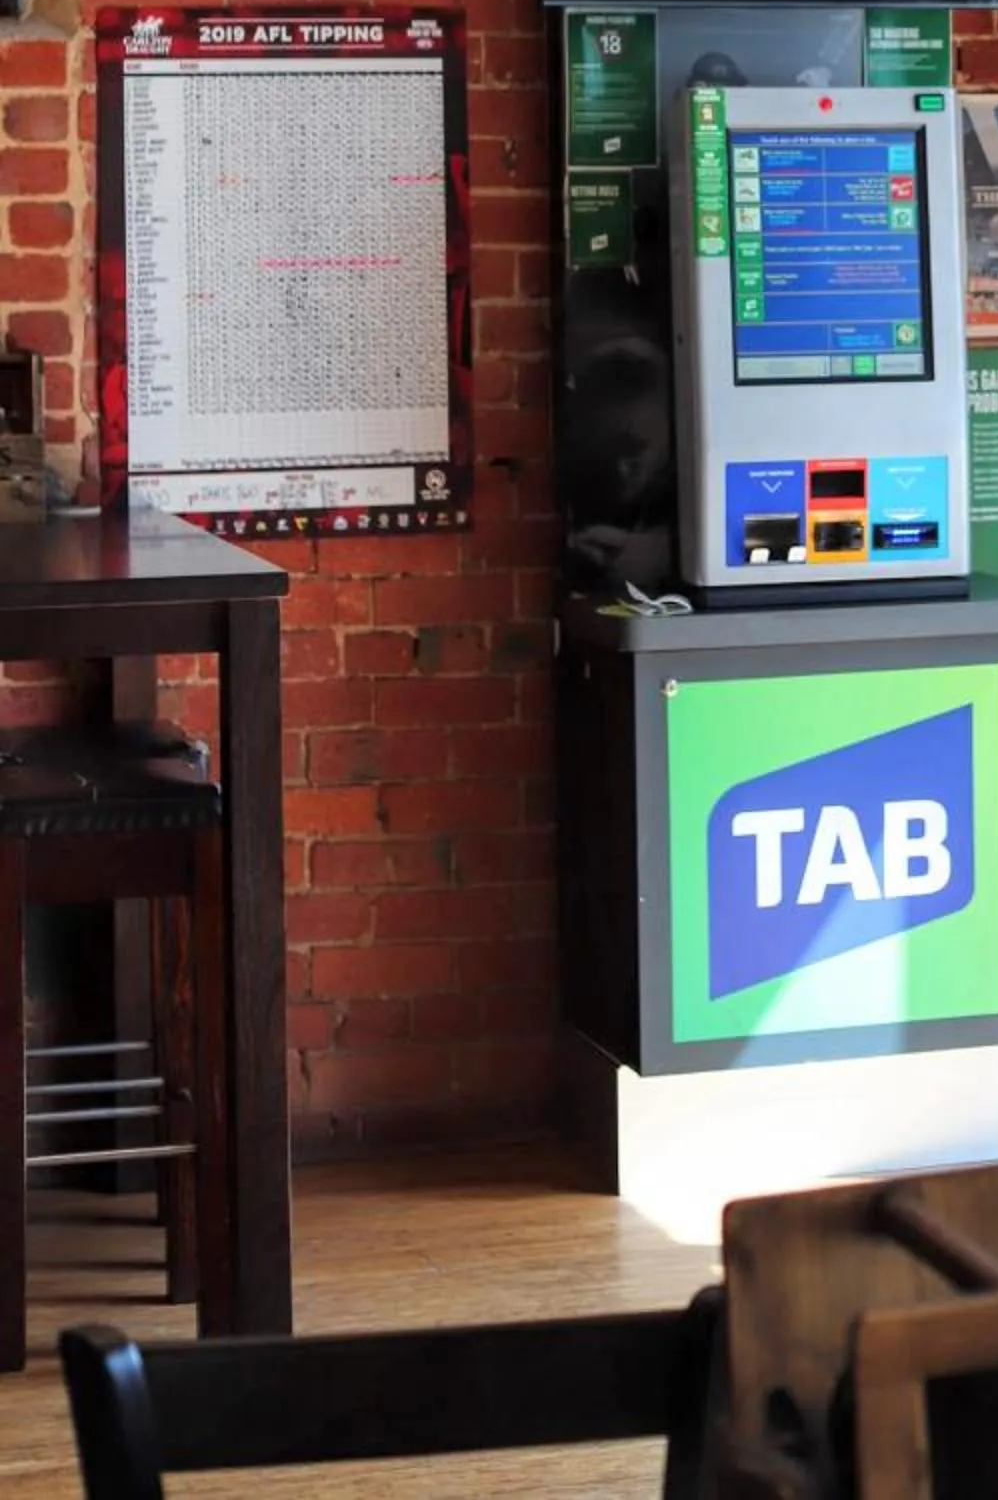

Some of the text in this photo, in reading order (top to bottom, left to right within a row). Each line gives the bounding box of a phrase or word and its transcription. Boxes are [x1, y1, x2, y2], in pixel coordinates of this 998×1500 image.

[200, 25, 384, 44] 2019 AFL TIPPING
[600, 35, 622, 55] 18
[731, 799, 952, 909] TAB
